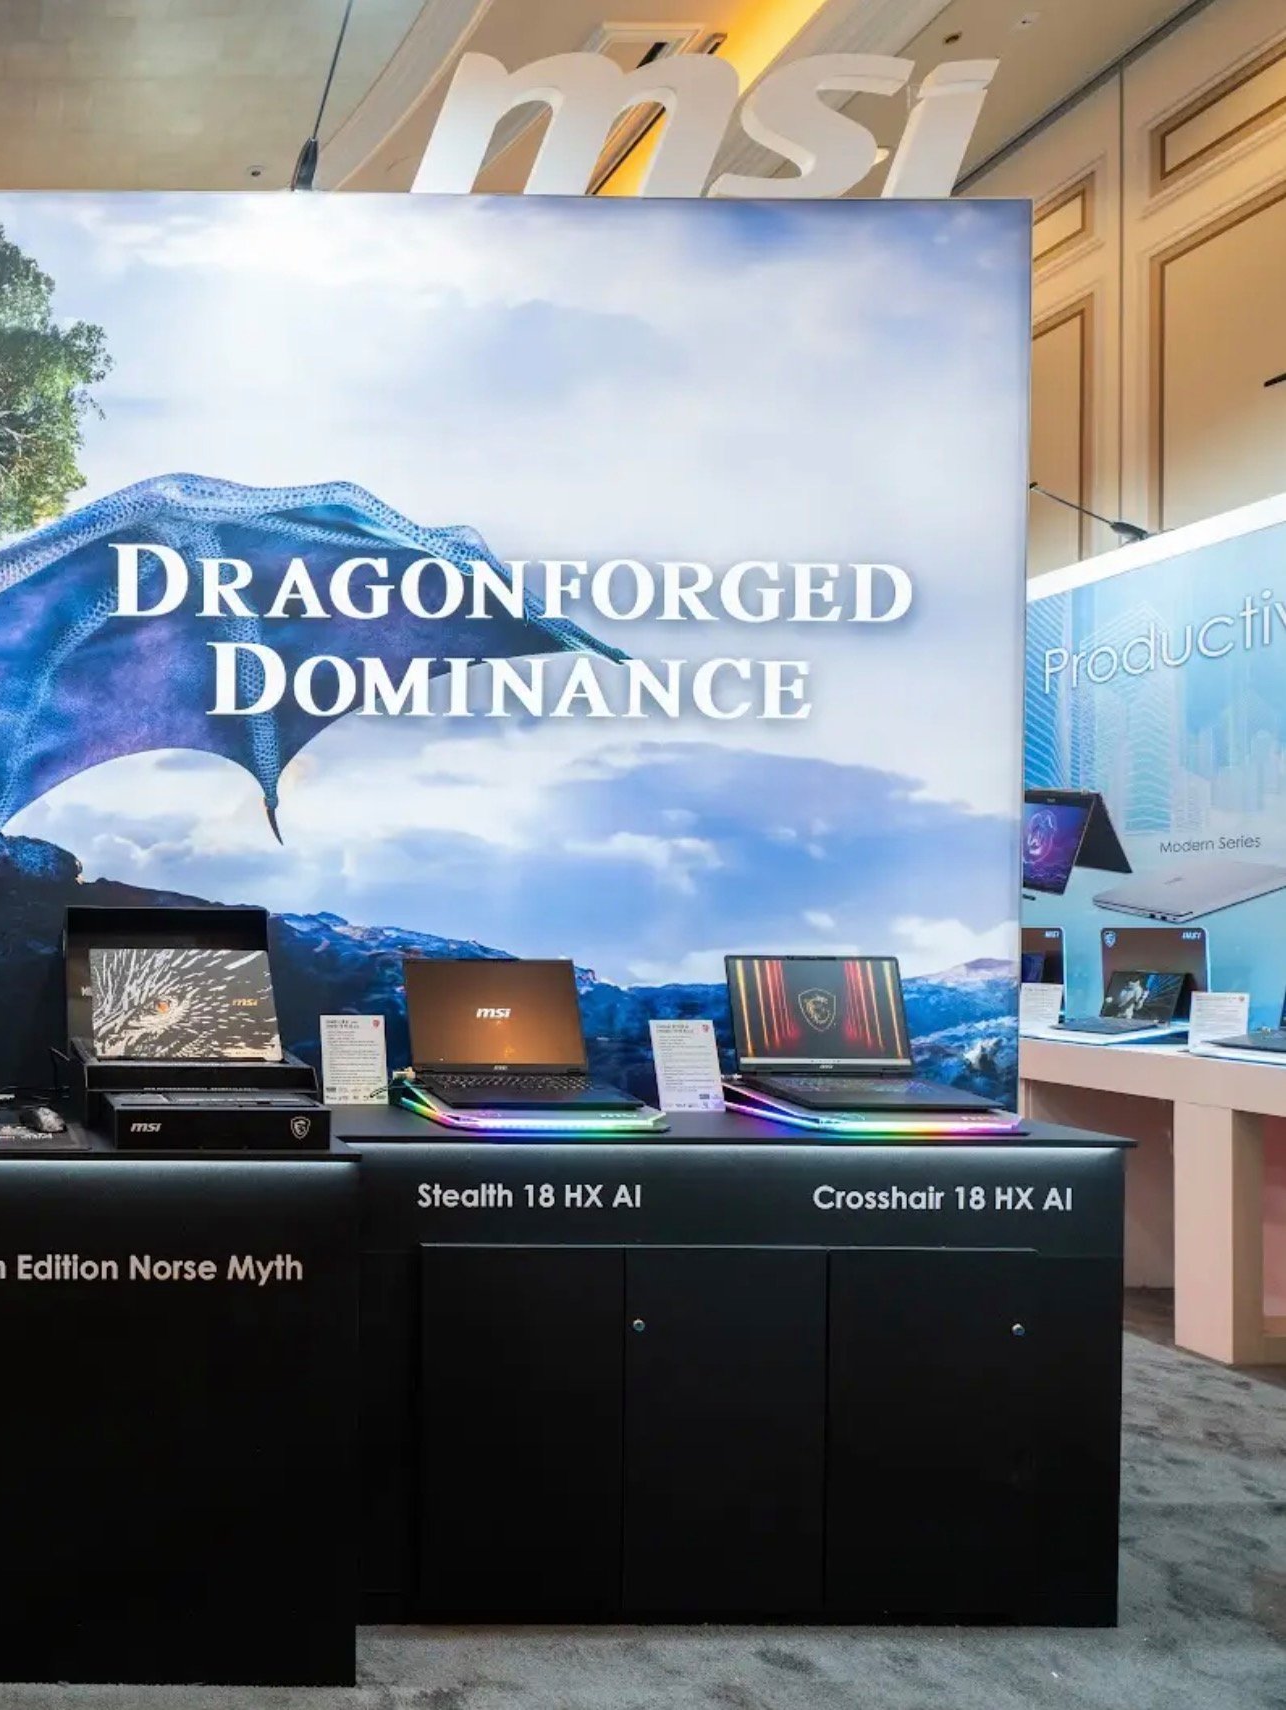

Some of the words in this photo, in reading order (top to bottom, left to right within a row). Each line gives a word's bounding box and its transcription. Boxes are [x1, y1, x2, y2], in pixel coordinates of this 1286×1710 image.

[410, 52, 1000, 199] msi
[108, 543, 914, 624] DRAGONFORGED
[205, 641, 814, 720] DOMINANCE
[1159, 838, 1215, 854] Modern
[1218, 834, 1262, 850] Series
[476, 1007, 512, 1019] msi
[130, 1122, 162, 1133] msi
[417, 1183, 513, 1208] Stealth
[524, 1183, 555, 1208] 18
[565, 1184, 604, 1208] HX
[612, 1184, 641, 1208] AI
[812, 1184, 945, 1210] Crosshair
[954, 1185, 986, 1211] 18
[995, 1186, 1035, 1210] HX
[1042, 1187, 1072, 1211] AI
[17, 1253, 119, 1281] Edition
[129, 1254, 217, 1281] Norse
[227, 1254, 303, 1286] Myth
